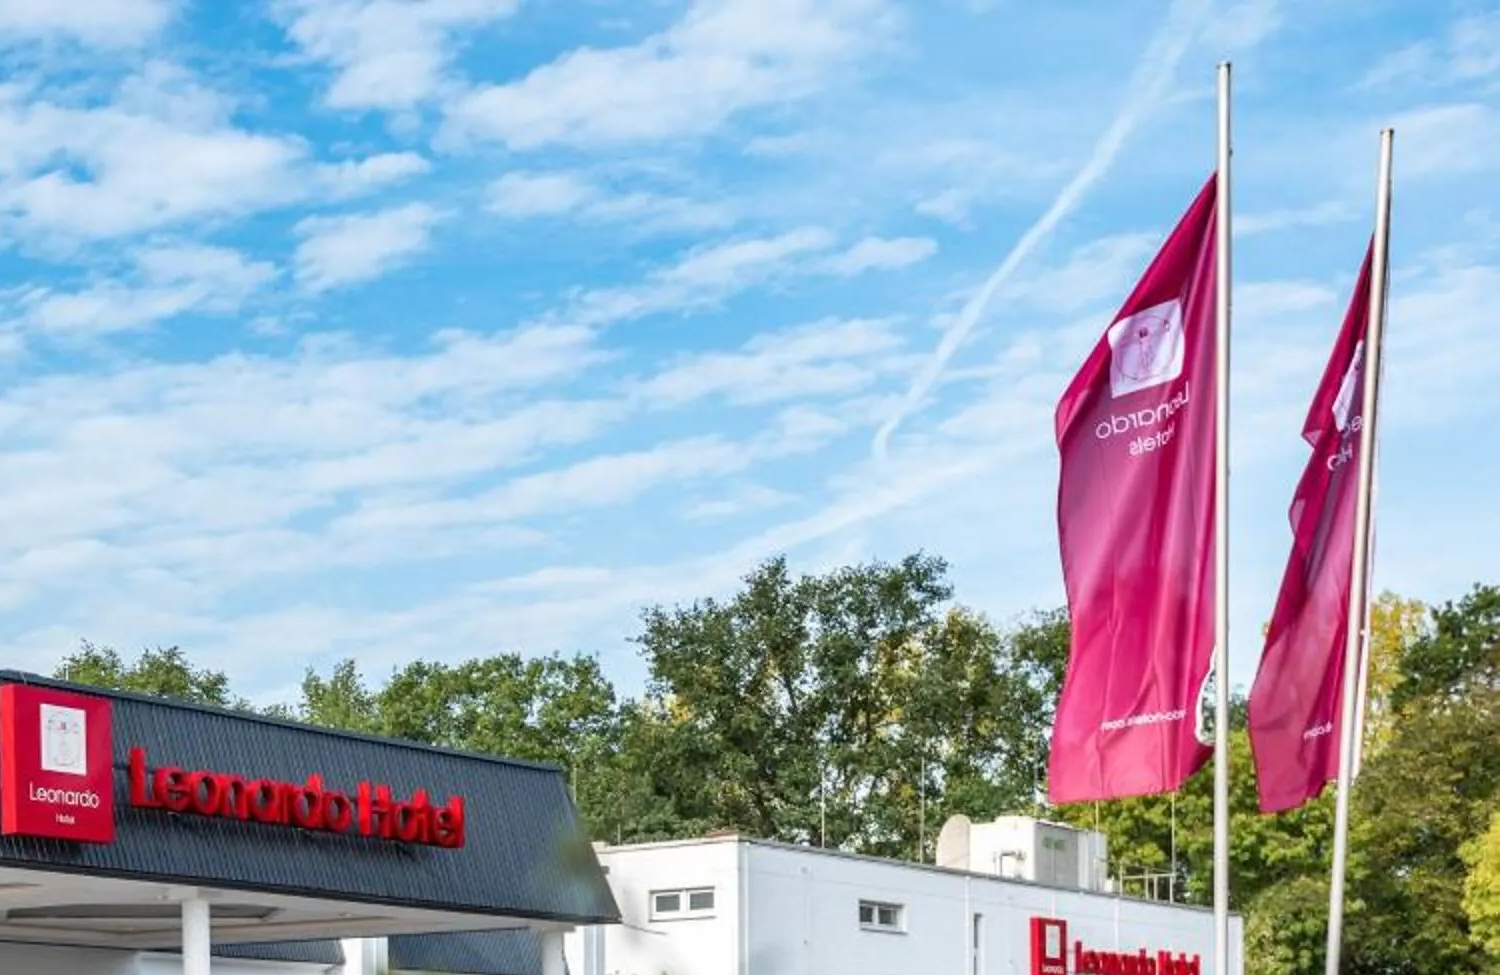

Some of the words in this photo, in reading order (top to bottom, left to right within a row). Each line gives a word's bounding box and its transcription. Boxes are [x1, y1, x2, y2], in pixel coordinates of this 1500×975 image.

[29, 781, 100, 809] Leonardo
[127, 745, 352, 833] Leonardo
[357, 780, 465, 849] Hotel
